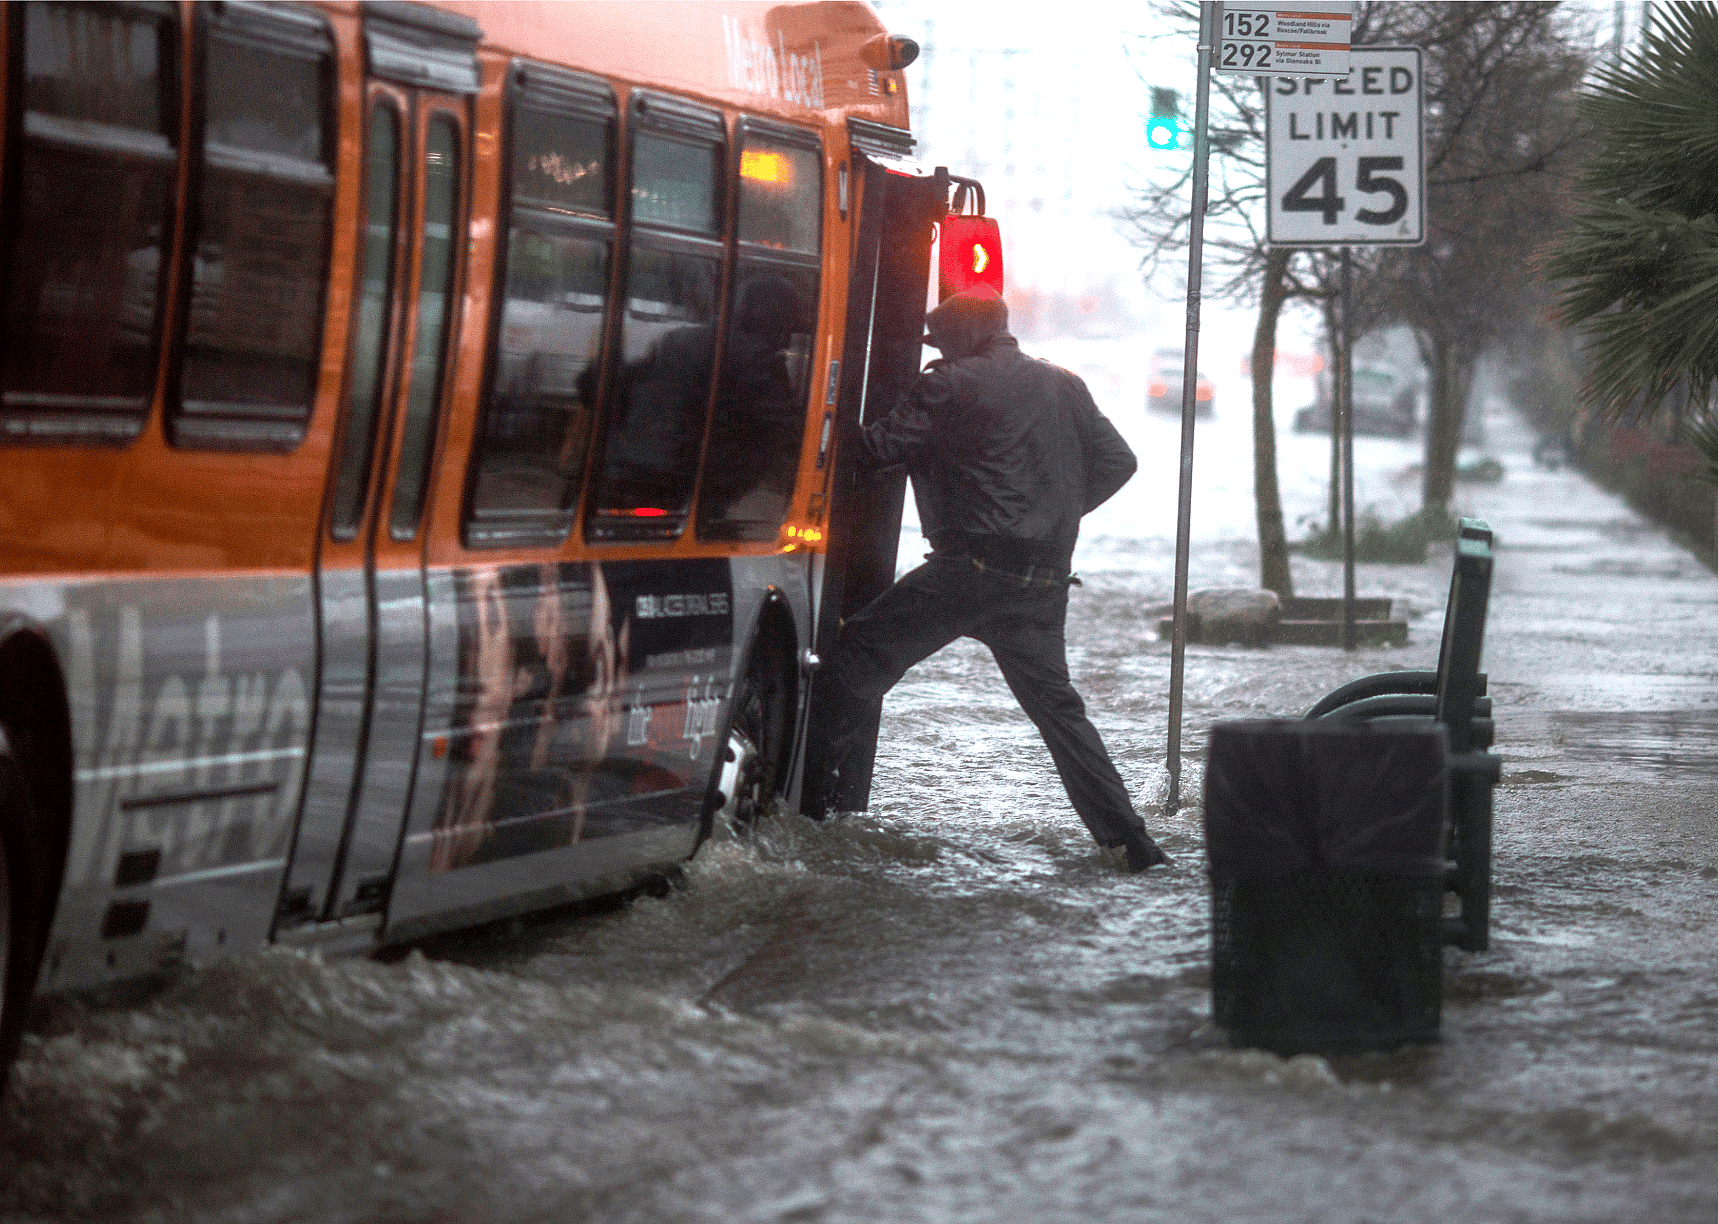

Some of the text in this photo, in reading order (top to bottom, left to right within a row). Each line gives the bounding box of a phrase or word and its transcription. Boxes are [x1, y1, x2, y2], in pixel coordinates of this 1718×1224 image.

[1224, 12, 1270, 37] 152
[1222, 43, 1272, 68] 292
[1275, 50, 1297, 58] Sylmar
[1276, 66, 1414, 96] SPEED
[1289, 111, 1400, 141] LIMIT
[1281, 156, 1409, 226] 45
